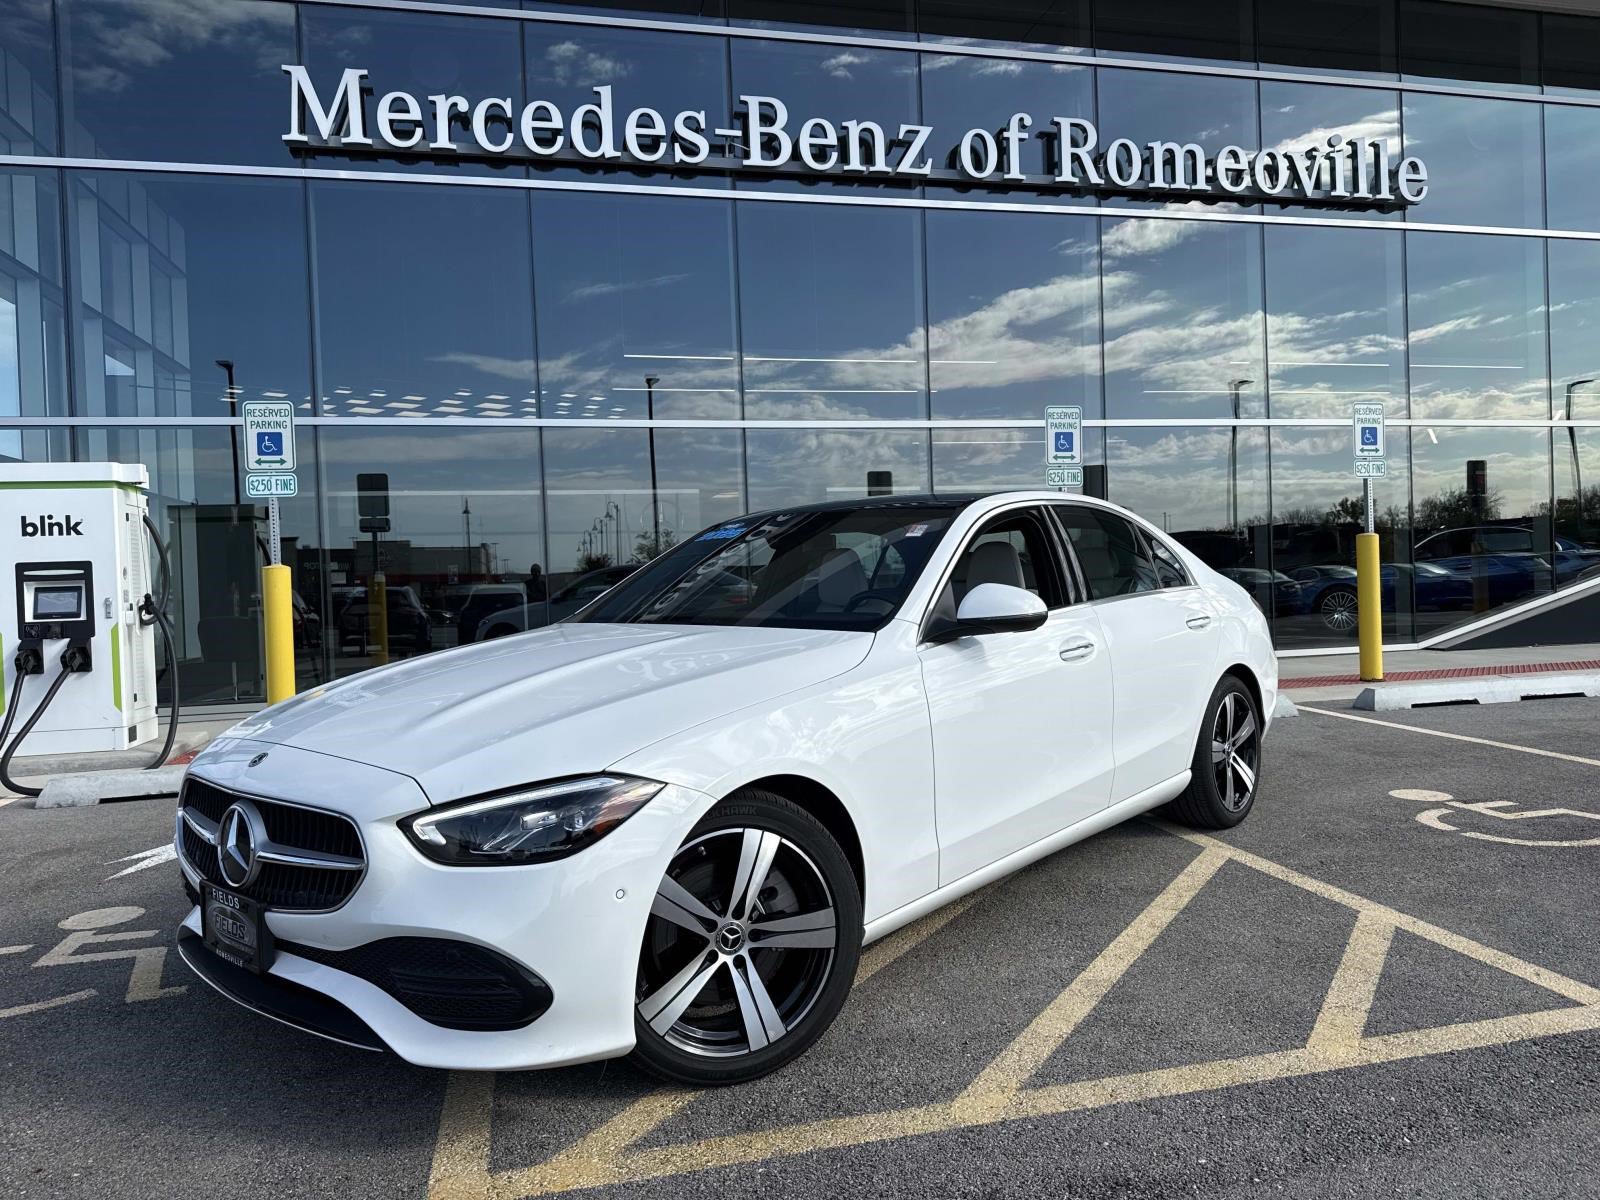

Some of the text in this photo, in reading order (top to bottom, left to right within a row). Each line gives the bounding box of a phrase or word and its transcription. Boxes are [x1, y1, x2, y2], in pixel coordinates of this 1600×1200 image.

[281, 64, 1429, 202] Mercedes-Benz of Romeoville
[246, 408, 290, 418] RESERVED
[1048, 411, 1080, 420] RESERVED
[1355, 407, 1383, 415] RESERVED
[250, 420, 288, 429] PARKING
[1050, 421, 1078, 430] PARKING
[1357, 417, 1381, 425] PARKING
[1356, 463, 1384, 474] $250 FINE
[1048, 471, 1081, 483] $250 FINE
[250, 478, 294, 492] $250 FINE
[20, 514, 84, 537] blink
[212, 887, 240, 909] FIELDS
[214, 913, 247, 940] FIELDS
